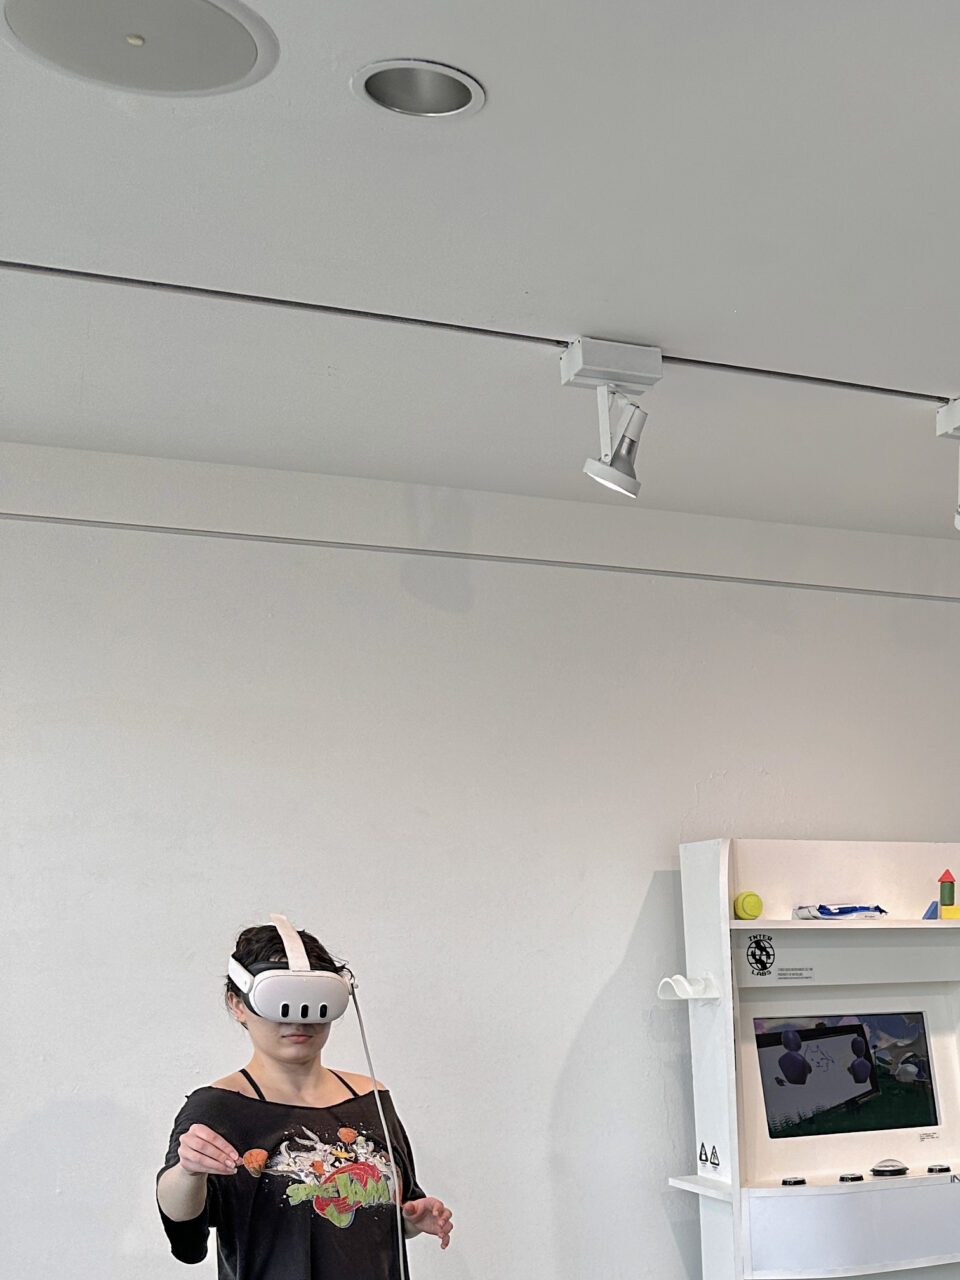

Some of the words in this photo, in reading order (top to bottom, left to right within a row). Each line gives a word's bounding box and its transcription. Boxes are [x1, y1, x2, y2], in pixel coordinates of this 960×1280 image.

[748, 933, 773, 942] INTER
[751, 969, 772, 977] LABS
[286, 1183, 339, 1206] SPACE
